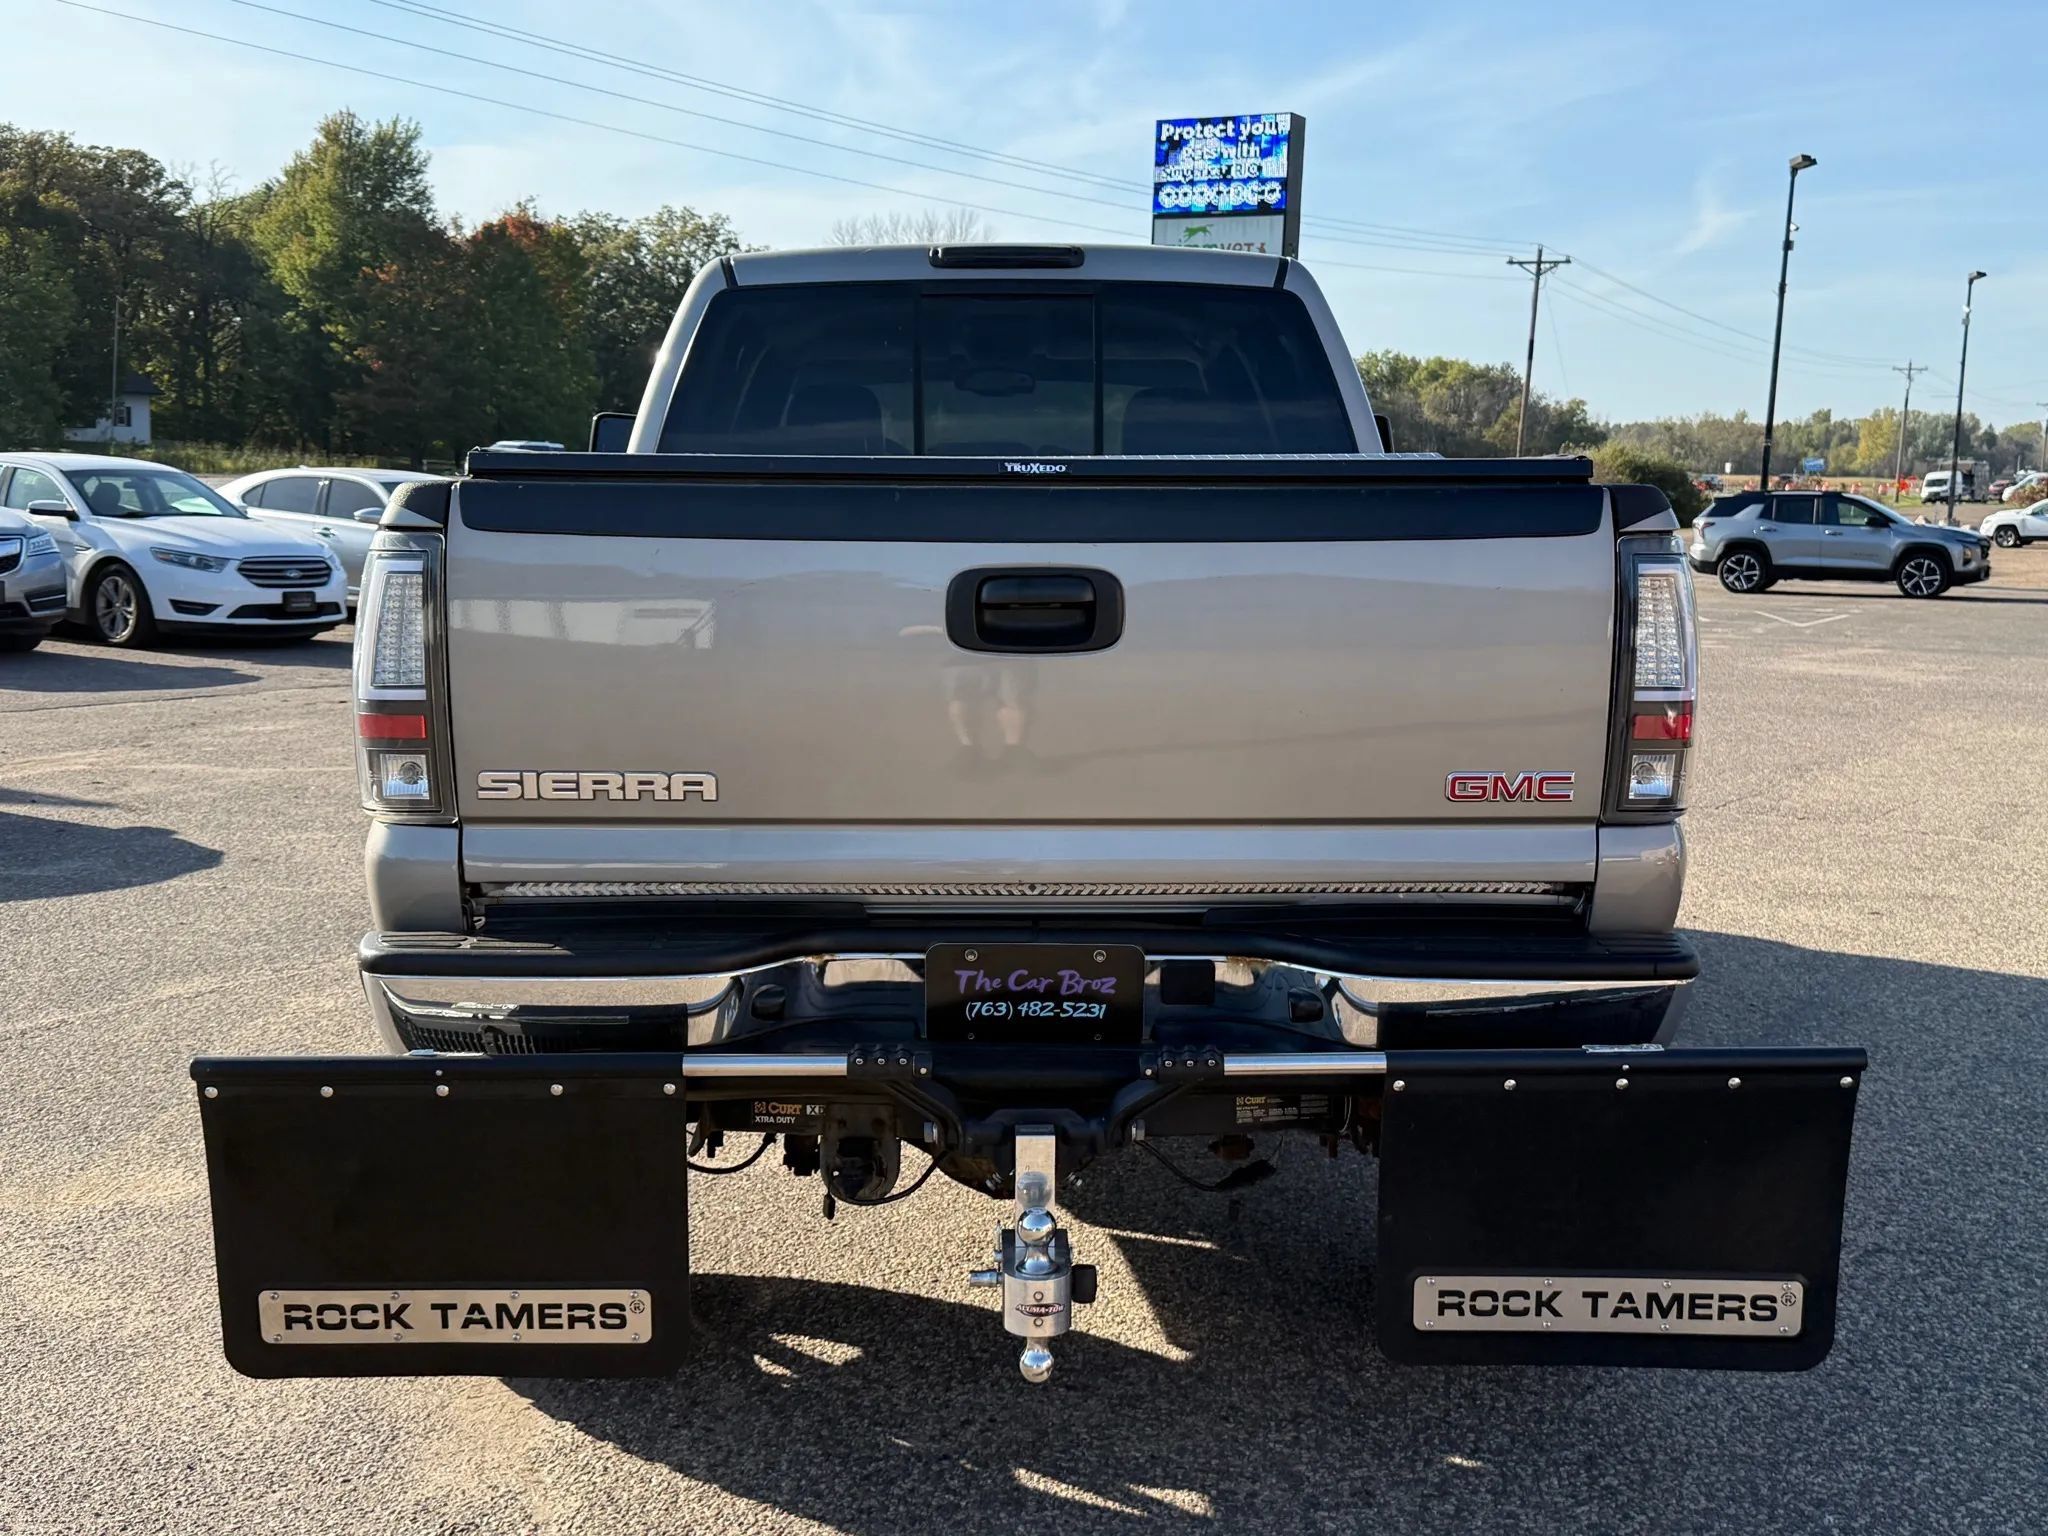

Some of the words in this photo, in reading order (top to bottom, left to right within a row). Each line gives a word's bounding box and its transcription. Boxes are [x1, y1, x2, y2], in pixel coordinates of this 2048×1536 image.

[477, 770, 719, 801] SIERRA
[1445, 770, 1575, 802] GMC
[954, 969, 1002, 995] The
[1007, 969, 1054, 994] Car
[1057, 969, 1117, 996] Broz
[965, 1001, 1014, 1020] (763)
[1017, 1001, 1107, 1019] 482-5231
[768, 1101, 802, 1115] CURT
[1244, 1096, 1266, 1105] CURT
[755, 1115, 775, 1123] XTRA
[776, 1116, 796, 1124] DUTY
[283, 1303, 414, 1331] ROCK
[1437, 1289, 1563, 1318] ROCK
